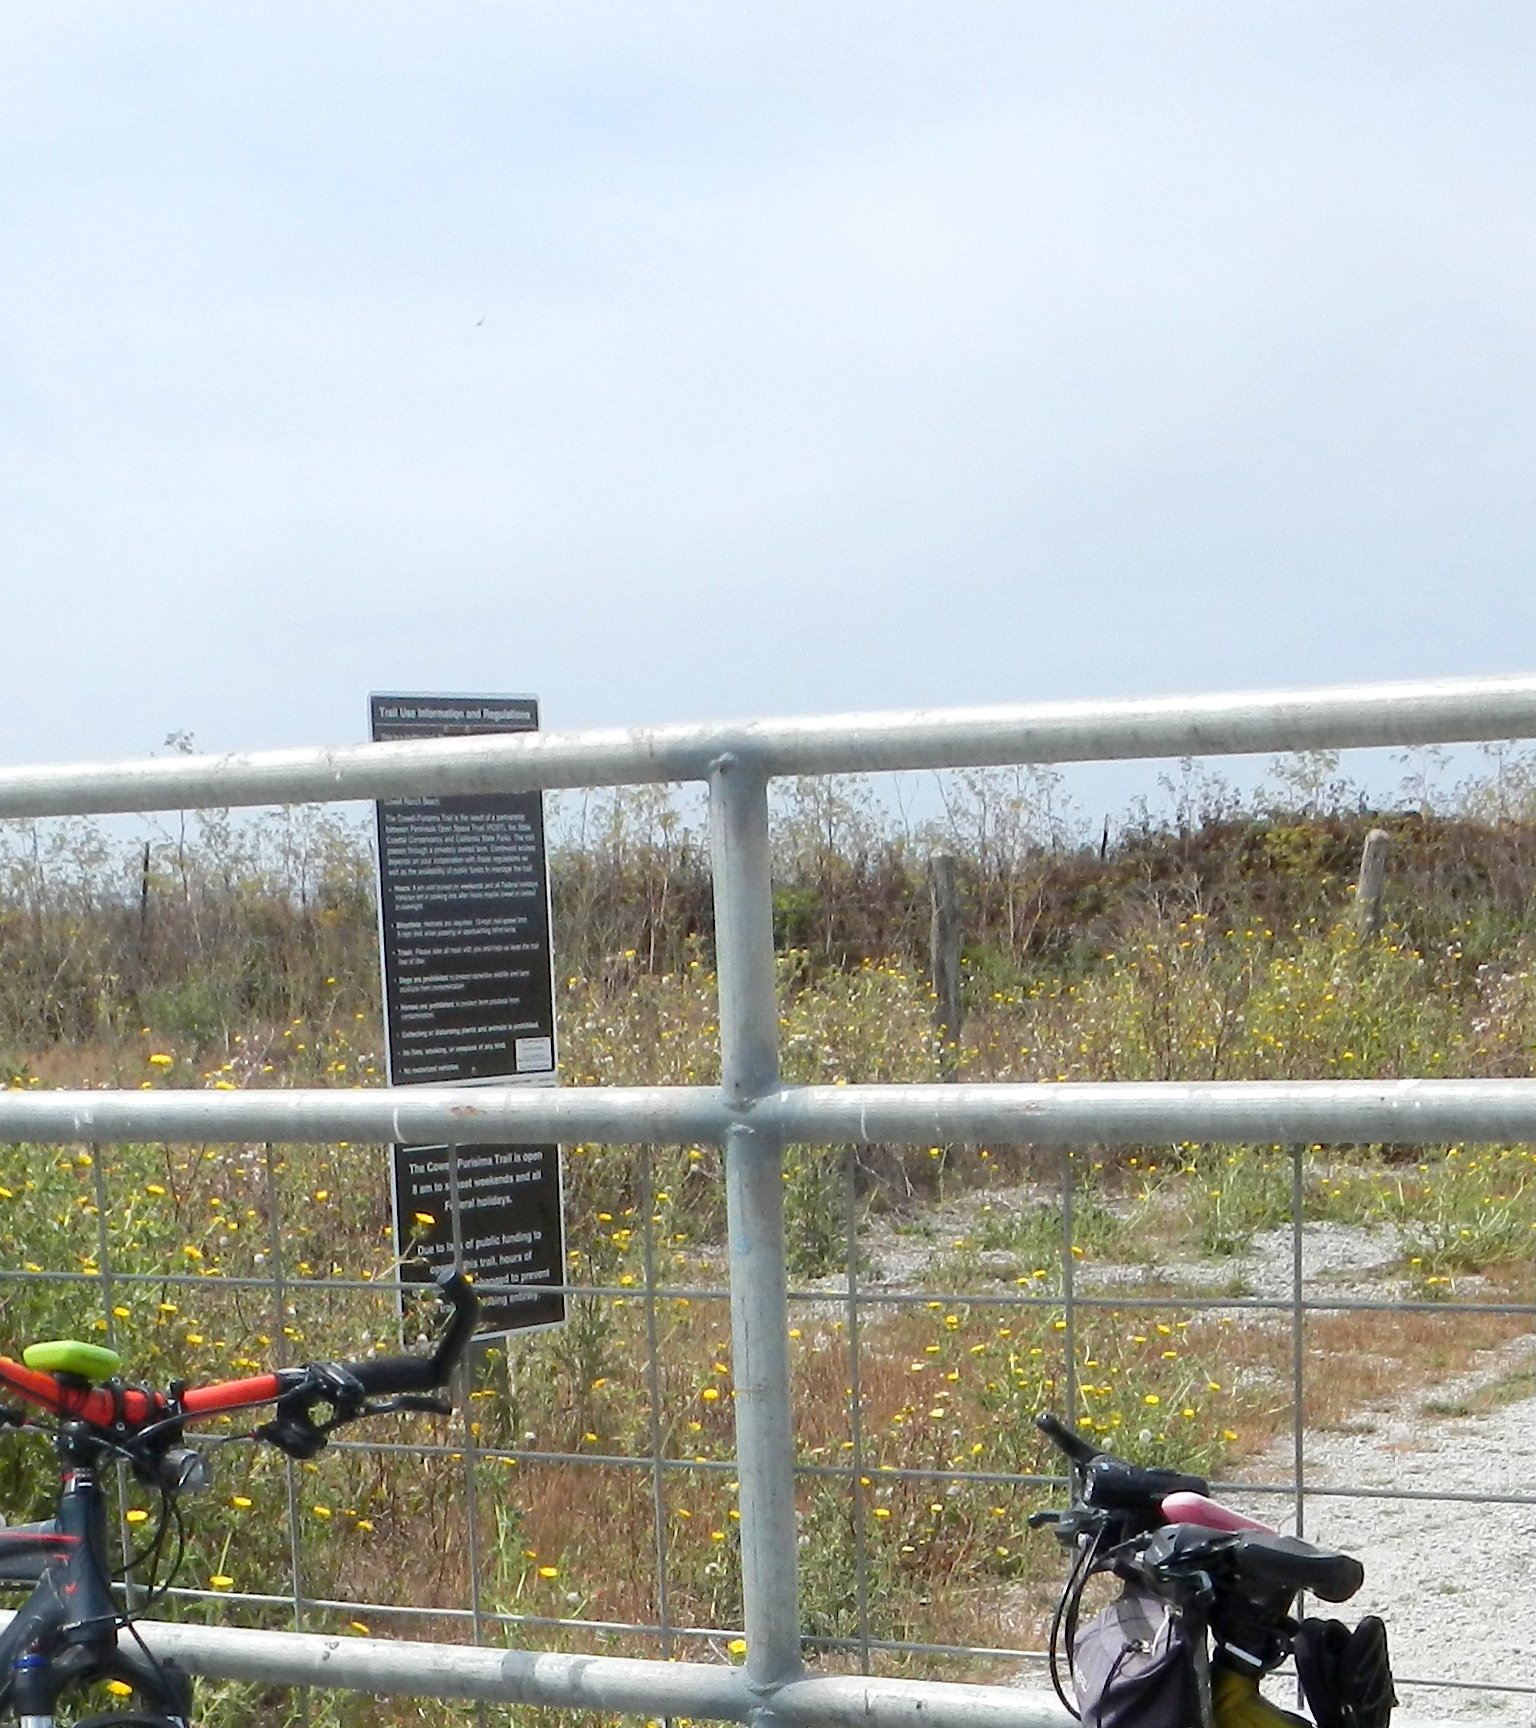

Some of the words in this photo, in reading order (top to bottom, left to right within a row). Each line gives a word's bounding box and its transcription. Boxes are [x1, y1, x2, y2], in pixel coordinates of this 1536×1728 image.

[379, 707, 398, 718] Trail
[400, 707, 416, 718] Use
[417, 708, 464, 719] Information
[465, 709, 481, 719] and
[409, 1163, 425, 1173] The
[494, 1154, 512, 1164] Trail
[514, 1153, 521, 1162] is
[523, 1151, 542, 1163] open
[434, 1183, 442, 1192] to
[474, 1174, 513, 1186] weekends
[516, 1172, 530, 1182] and
[532, 1170, 542, 1180] all
[418, 1245, 434, 1255] Due
[437, 1244, 445, 1253] to
[465, 1239, 474, 1249] of
[476, 1236, 501, 1249] public
[502, 1232, 532, 1244] funding
[534, 1230, 541, 1240] to
[499, 1254, 522, 1266] hours
[523, 1251, 532, 1262] of
[511, 1272, 520, 1282] to
[521, 1269, 550, 1283] prevent
